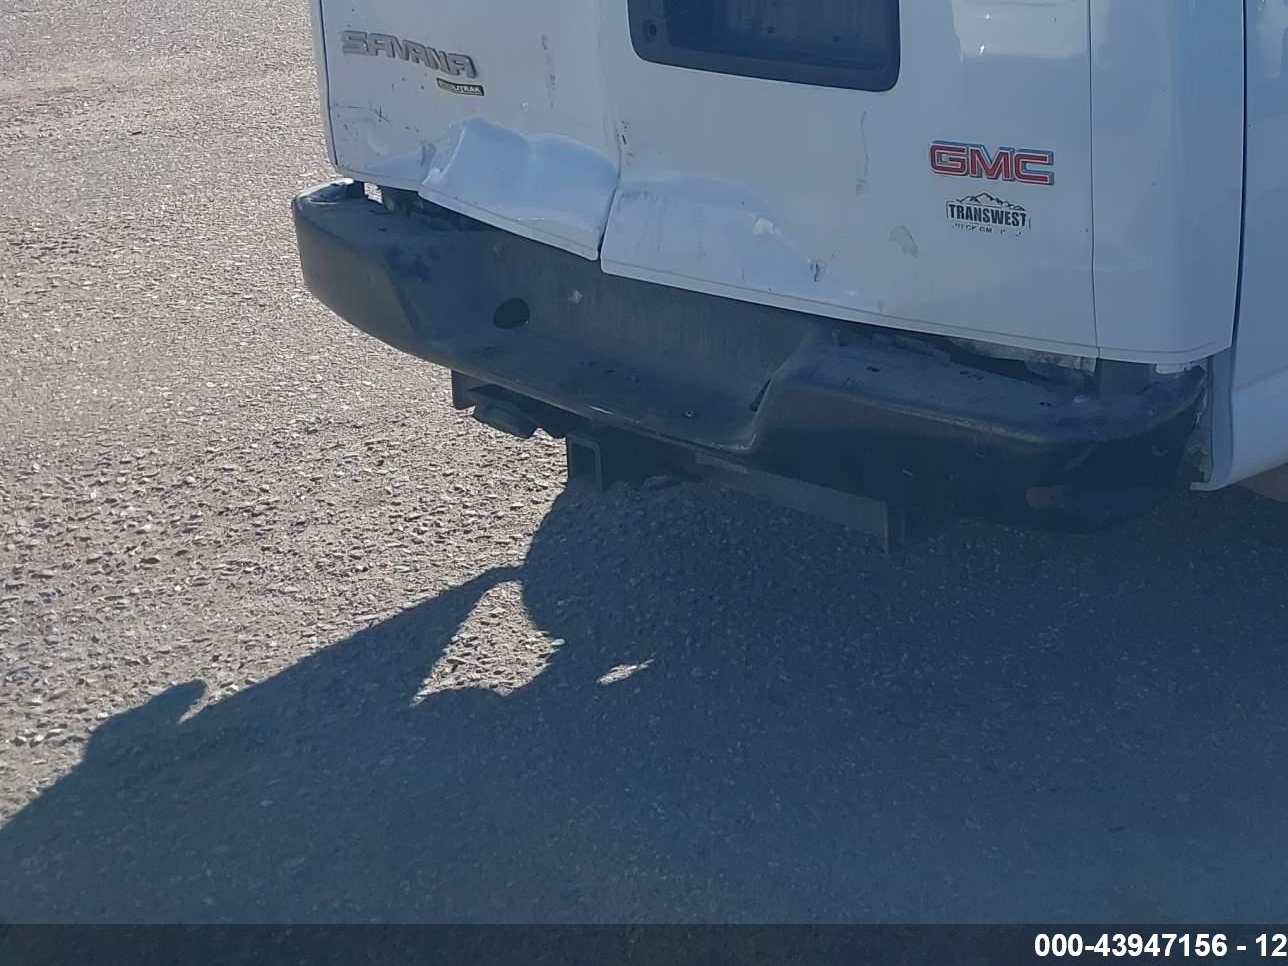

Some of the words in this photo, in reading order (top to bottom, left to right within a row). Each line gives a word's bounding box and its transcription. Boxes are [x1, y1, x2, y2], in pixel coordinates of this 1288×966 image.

[341, 30, 478, 79] SAVANA
[930, 140, 1055, 185] GMC
[948, 204, 1028, 226] TRANSWEST
